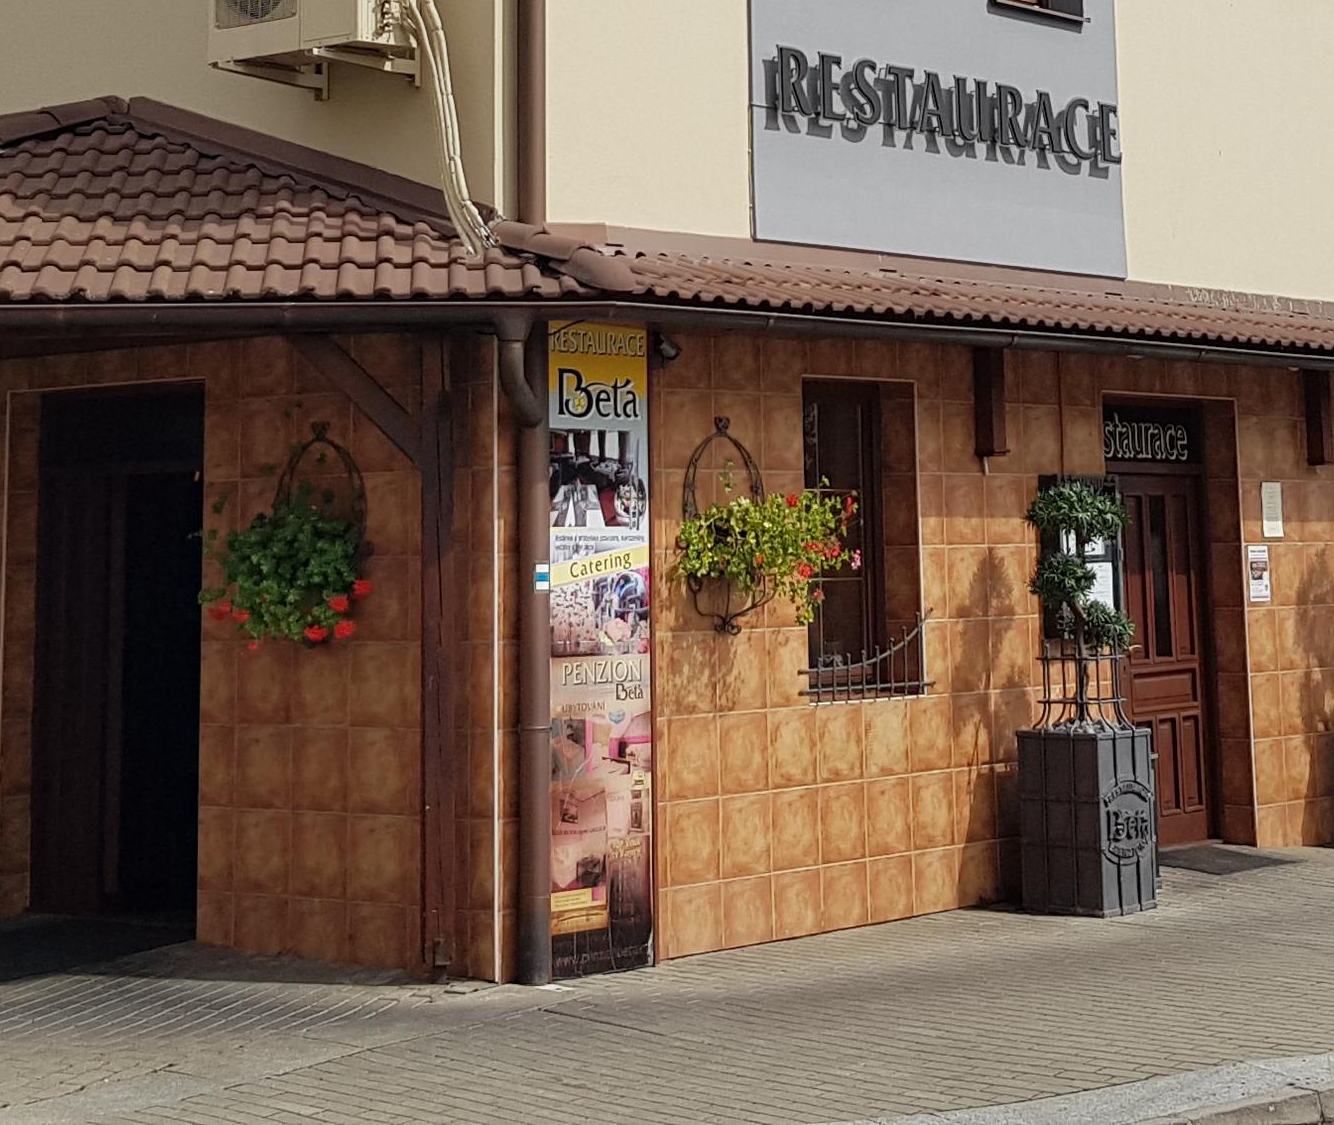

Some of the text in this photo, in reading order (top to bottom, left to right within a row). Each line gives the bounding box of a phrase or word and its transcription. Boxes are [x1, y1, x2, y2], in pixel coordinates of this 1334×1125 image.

[775, 43, 1122, 166] RESTAURACE
[549, 330, 645, 357] RESTAURACE
[1103, 412, 1189, 461] staurace
[569, 553, 632, 578] Catering
[562, 659, 642, 686] PENZION
